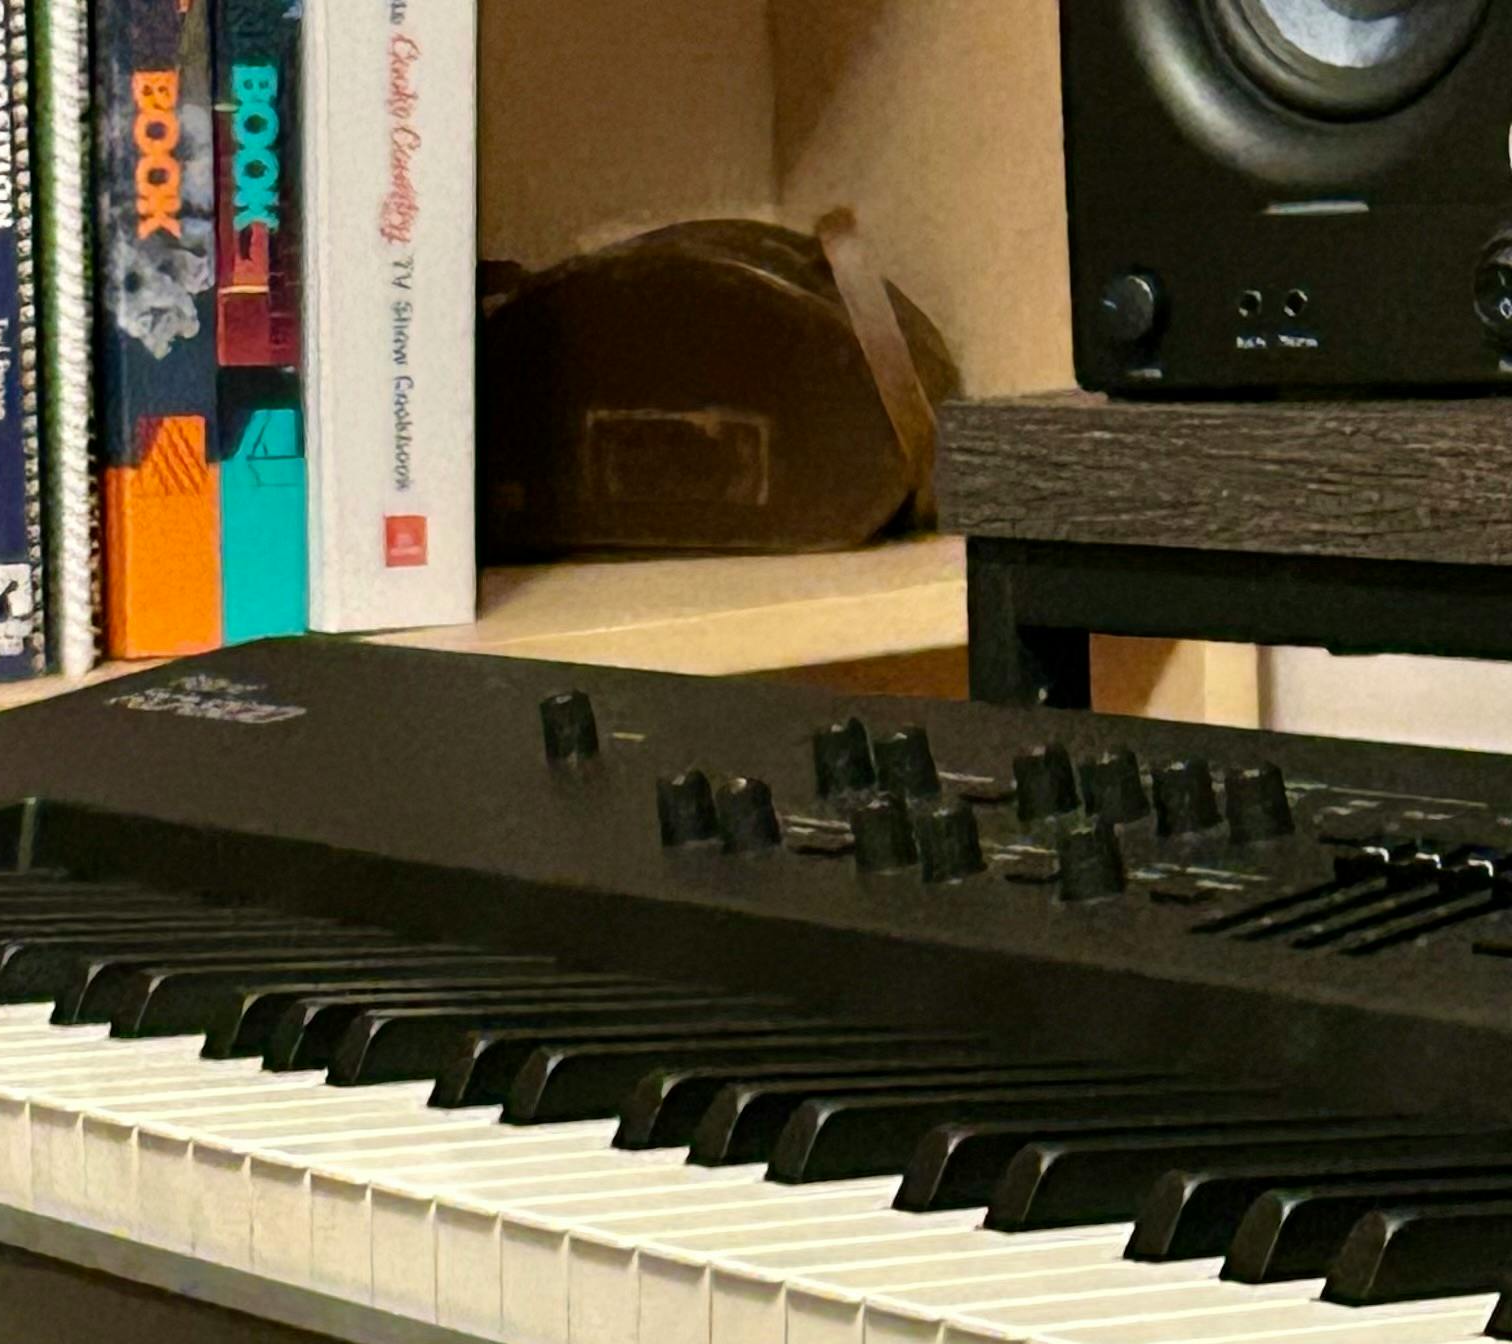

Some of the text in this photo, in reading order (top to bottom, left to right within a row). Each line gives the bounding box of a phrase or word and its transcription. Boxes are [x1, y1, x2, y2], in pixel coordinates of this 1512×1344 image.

[131, 69, 183, 241] BOOK
[232, 64, 280, 233] BOOK
[391, 256, 414, 292] TV
[392, 302, 414, 369] Show
